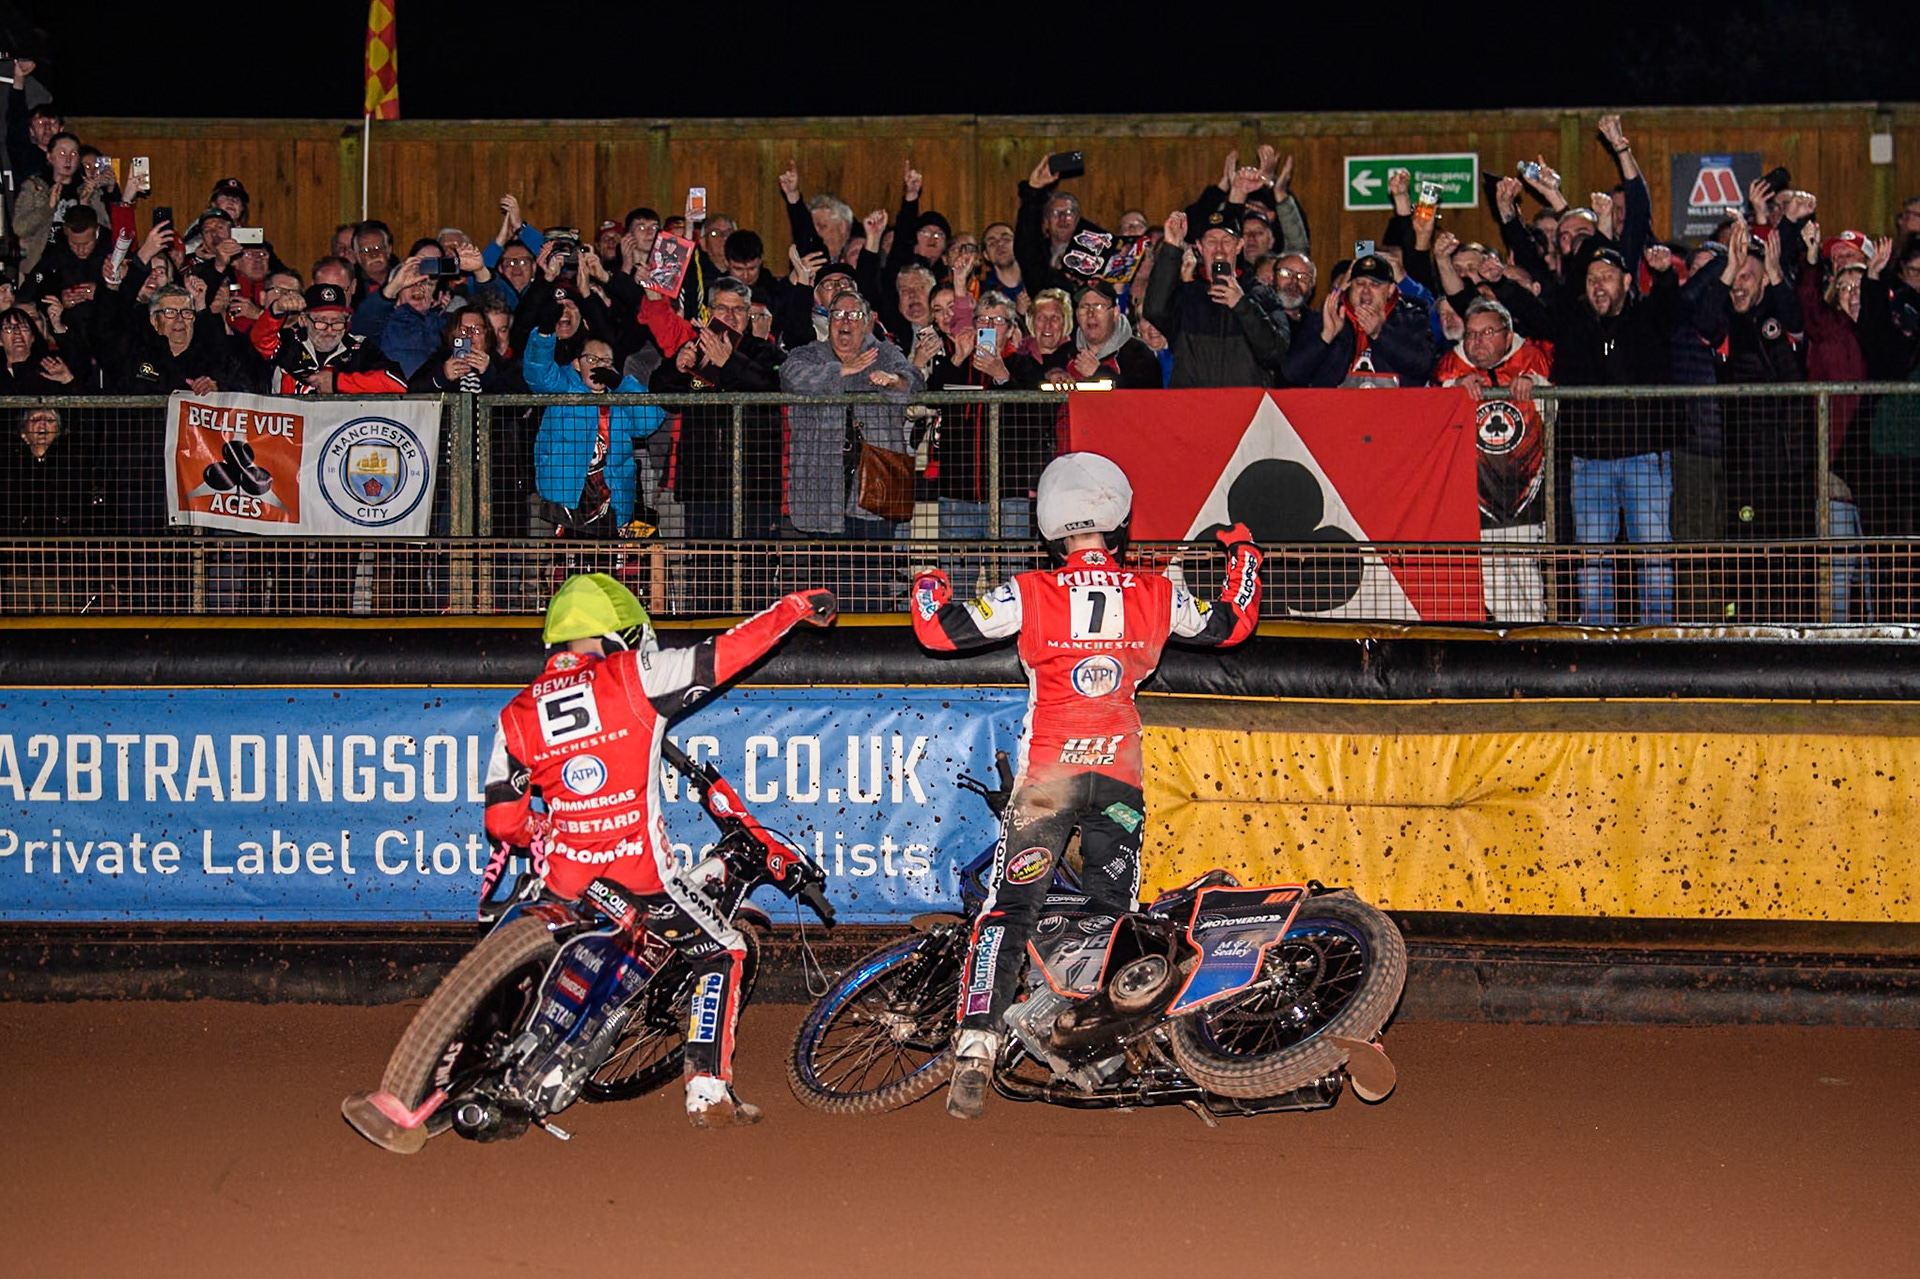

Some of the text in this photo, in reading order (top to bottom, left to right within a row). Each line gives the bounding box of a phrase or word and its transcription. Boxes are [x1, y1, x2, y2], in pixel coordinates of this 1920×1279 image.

[1414, 171, 1472, 182] Emergency
[188, 406, 296, 438] BELLE VUE
[331, 425, 417, 460] MANCHESTER
[327, 466, 337, 474] 18
[209, 492, 263, 518] ACES
[356, 506, 389, 519] CITY
[1057, 570, 1137, 588] KURTZ
[1087, 591, 1107, 633] 1
[1047, 640, 1145, 650] MANCHESTER
[532, 669, 597, 698] BEWLEY
[1081, 667, 1113, 682] ATPI
[544, 691, 591, 737] 5
[533, 728, 629, 762] MANCHESTER
[571, 766, 598, 782] ATPI
[560, 789, 637, 812] IMMERGAS
[567, 810, 641, 834] BETARD
[0, 829, 180, 874] Private
[203, 829, 356, 875] Label
[590, 880, 609, 897] BIO
[609, 895, 628, 915] OIL
[1200, 915, 1270, 930] MOTOVERDE
[1211, 946, 1252, 958] Sealey
[699, 974, 721, 1040] ALBON
